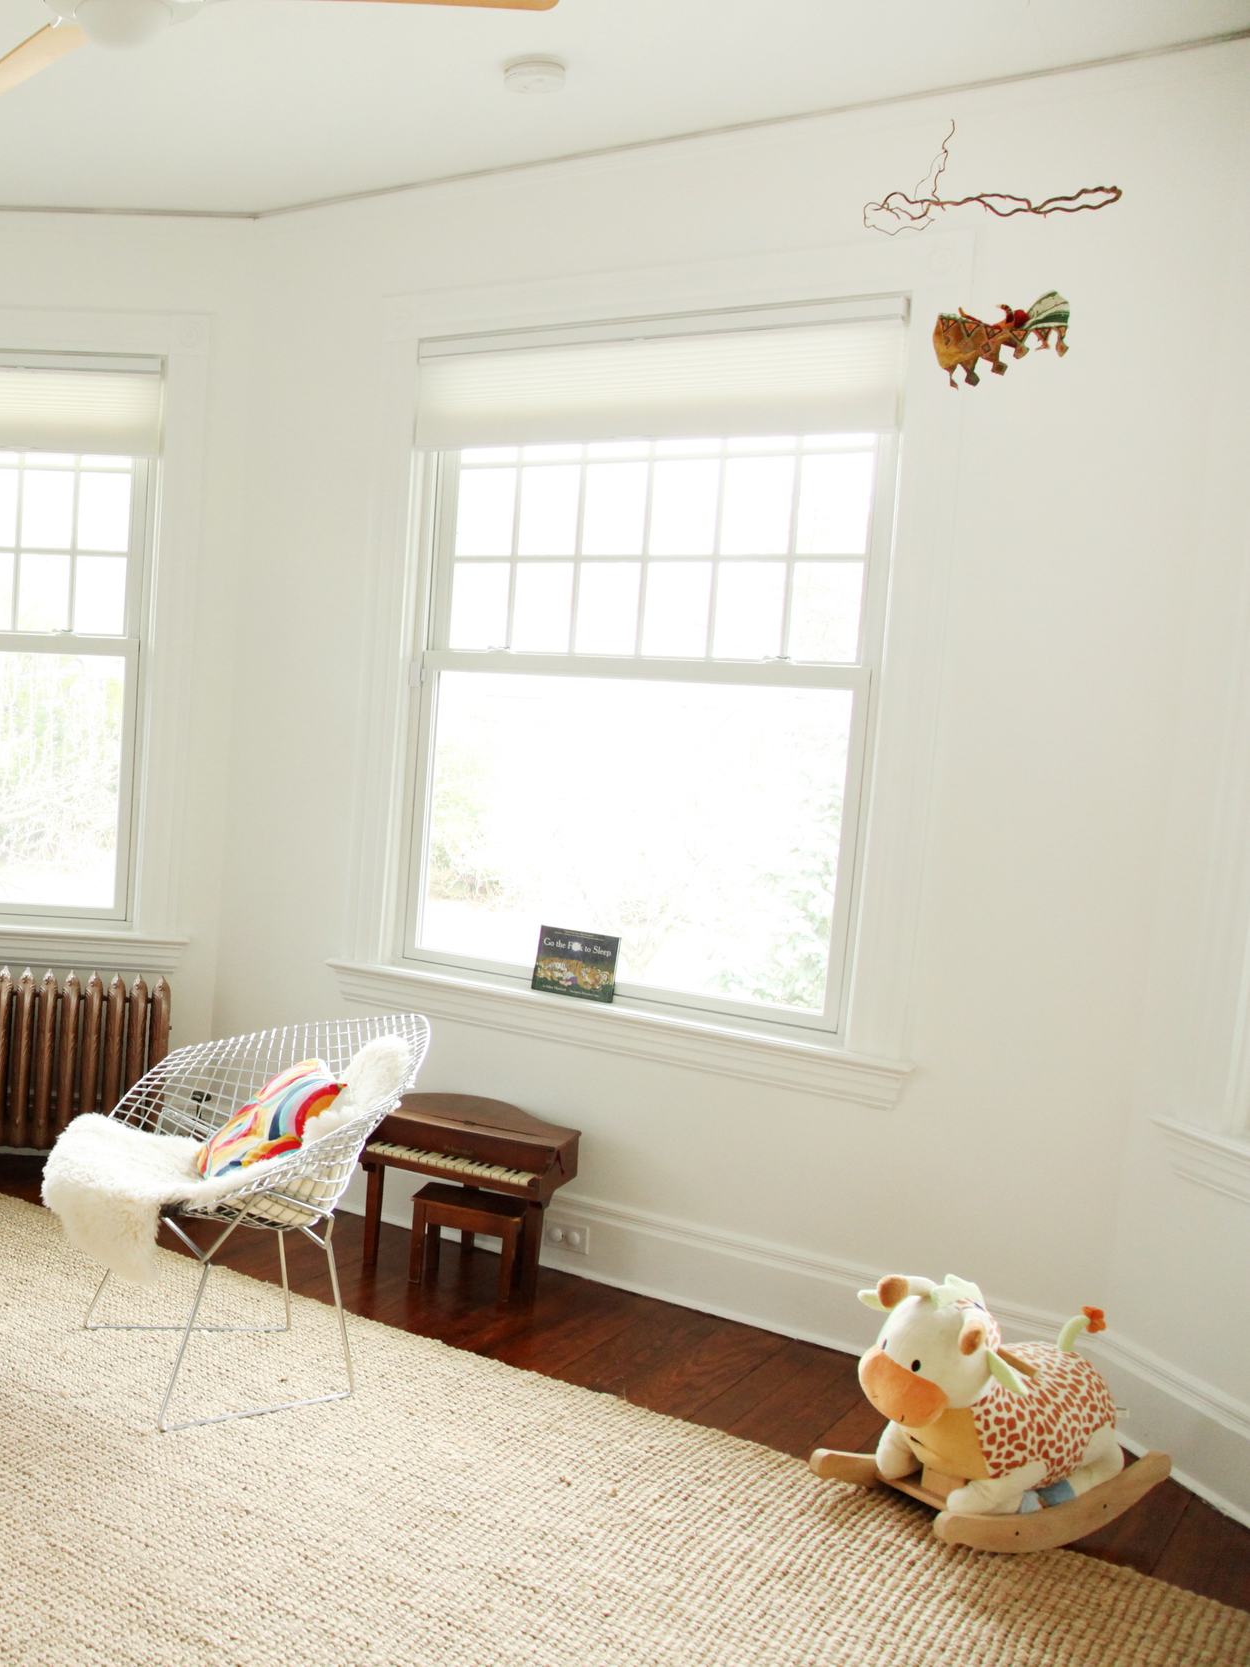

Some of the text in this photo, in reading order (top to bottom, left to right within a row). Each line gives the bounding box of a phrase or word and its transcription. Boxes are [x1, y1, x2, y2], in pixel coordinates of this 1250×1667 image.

[544, 937, 554, 946] Go
[556, 940, 566, 949] the
[567, 941, 583, 952] Fk
[593, 946, 611, 957] Sleep
